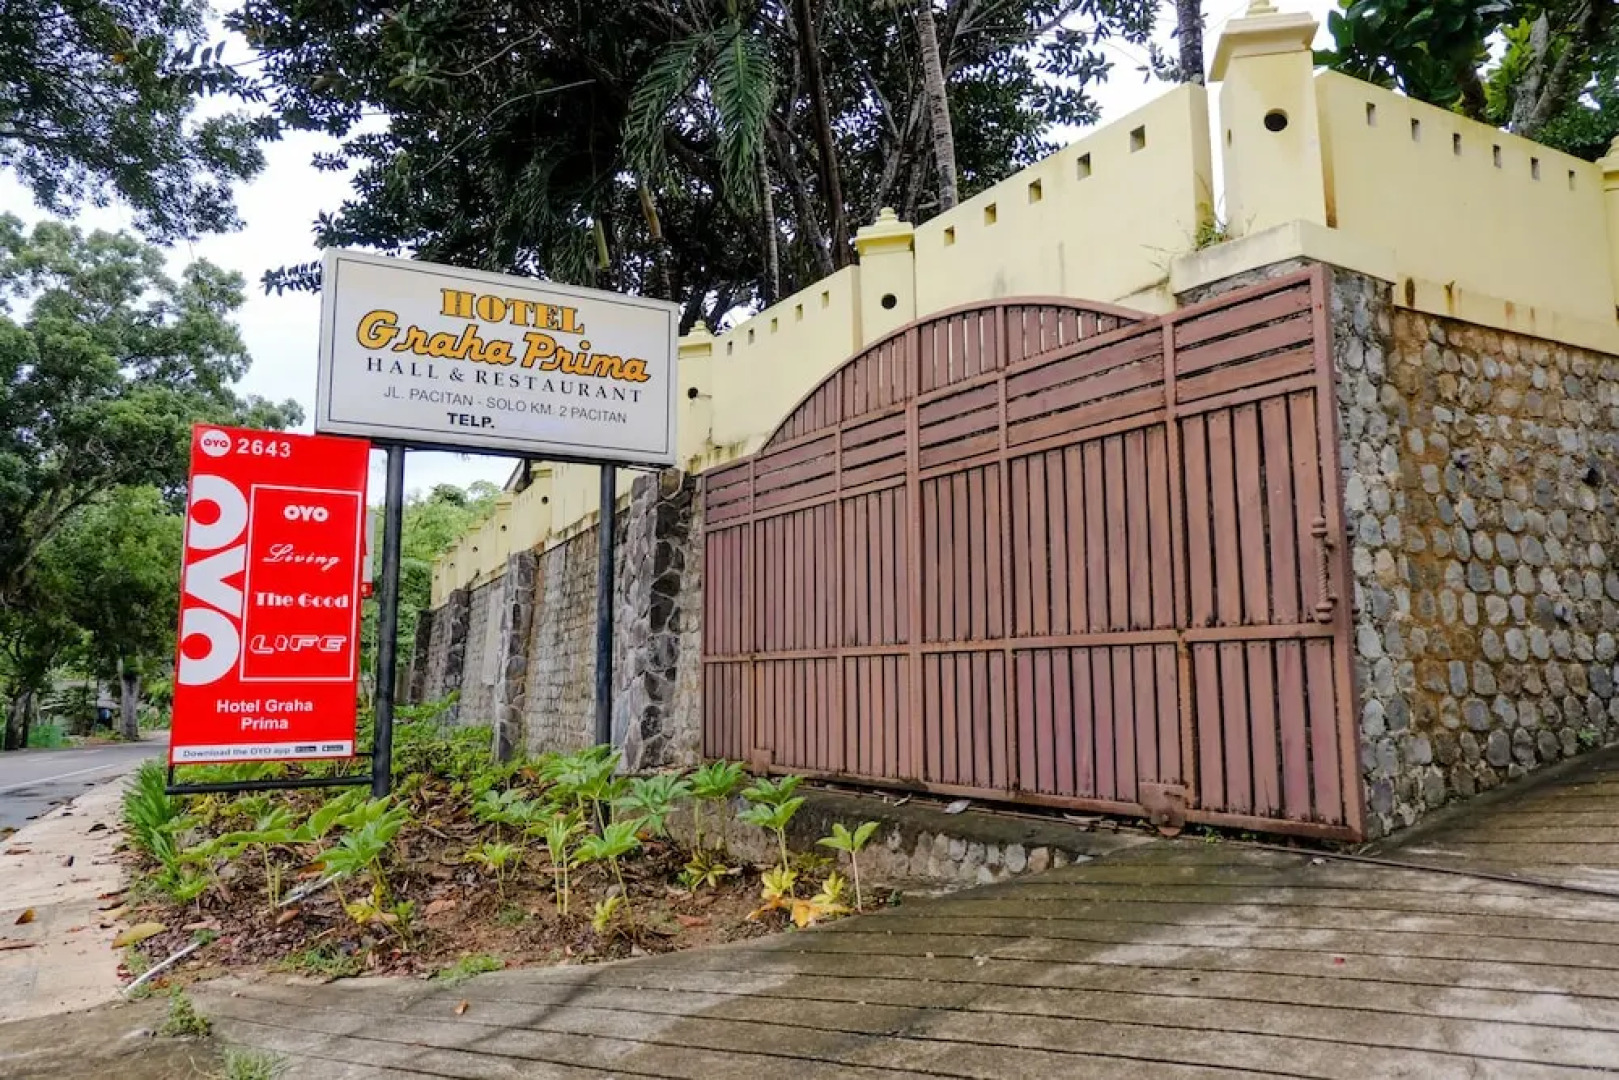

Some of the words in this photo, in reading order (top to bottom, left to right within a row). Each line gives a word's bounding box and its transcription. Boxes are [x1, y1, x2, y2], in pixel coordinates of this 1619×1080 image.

[440, 288, 585, 335] HOTEL
[357, 309, 517, 366] Graha
[521, 331, 652, 383] Prima
[366, 357, 439, 380] HALL
[449, 368, 464, 382] &
[475, 370, 642, 403] RESTAURANT
[384, 386, 405, 399] JL.
[409, 388, 474, 406] PACITAN
[486, 397, 527, 412] SOLO
[559, 406, 567, 417] 2
[571, 408, 627, 423] PACITAN
[446, 412, 495, 429] TELP.
[203, 438, 229, 448] OYO
[236, 438, 291, 458] 2643
[283, 504, 329, 522] OYO
[261, 543, 340, 571] Living
[255, 592, 293, 606] The
[298, 593, 349, 608] Good
[250, 634, 347, 655] LIFE
[216, 700, 260, 713] Hotel
[265, 699, 313, 712] Graha
[240, 716, 289, 731] Prima
[182, 749, 231, 758] Download
[232, 747, 248, 755] the
[250, 747, 271, 755] OYO
[274, 747, 291, 755] app
